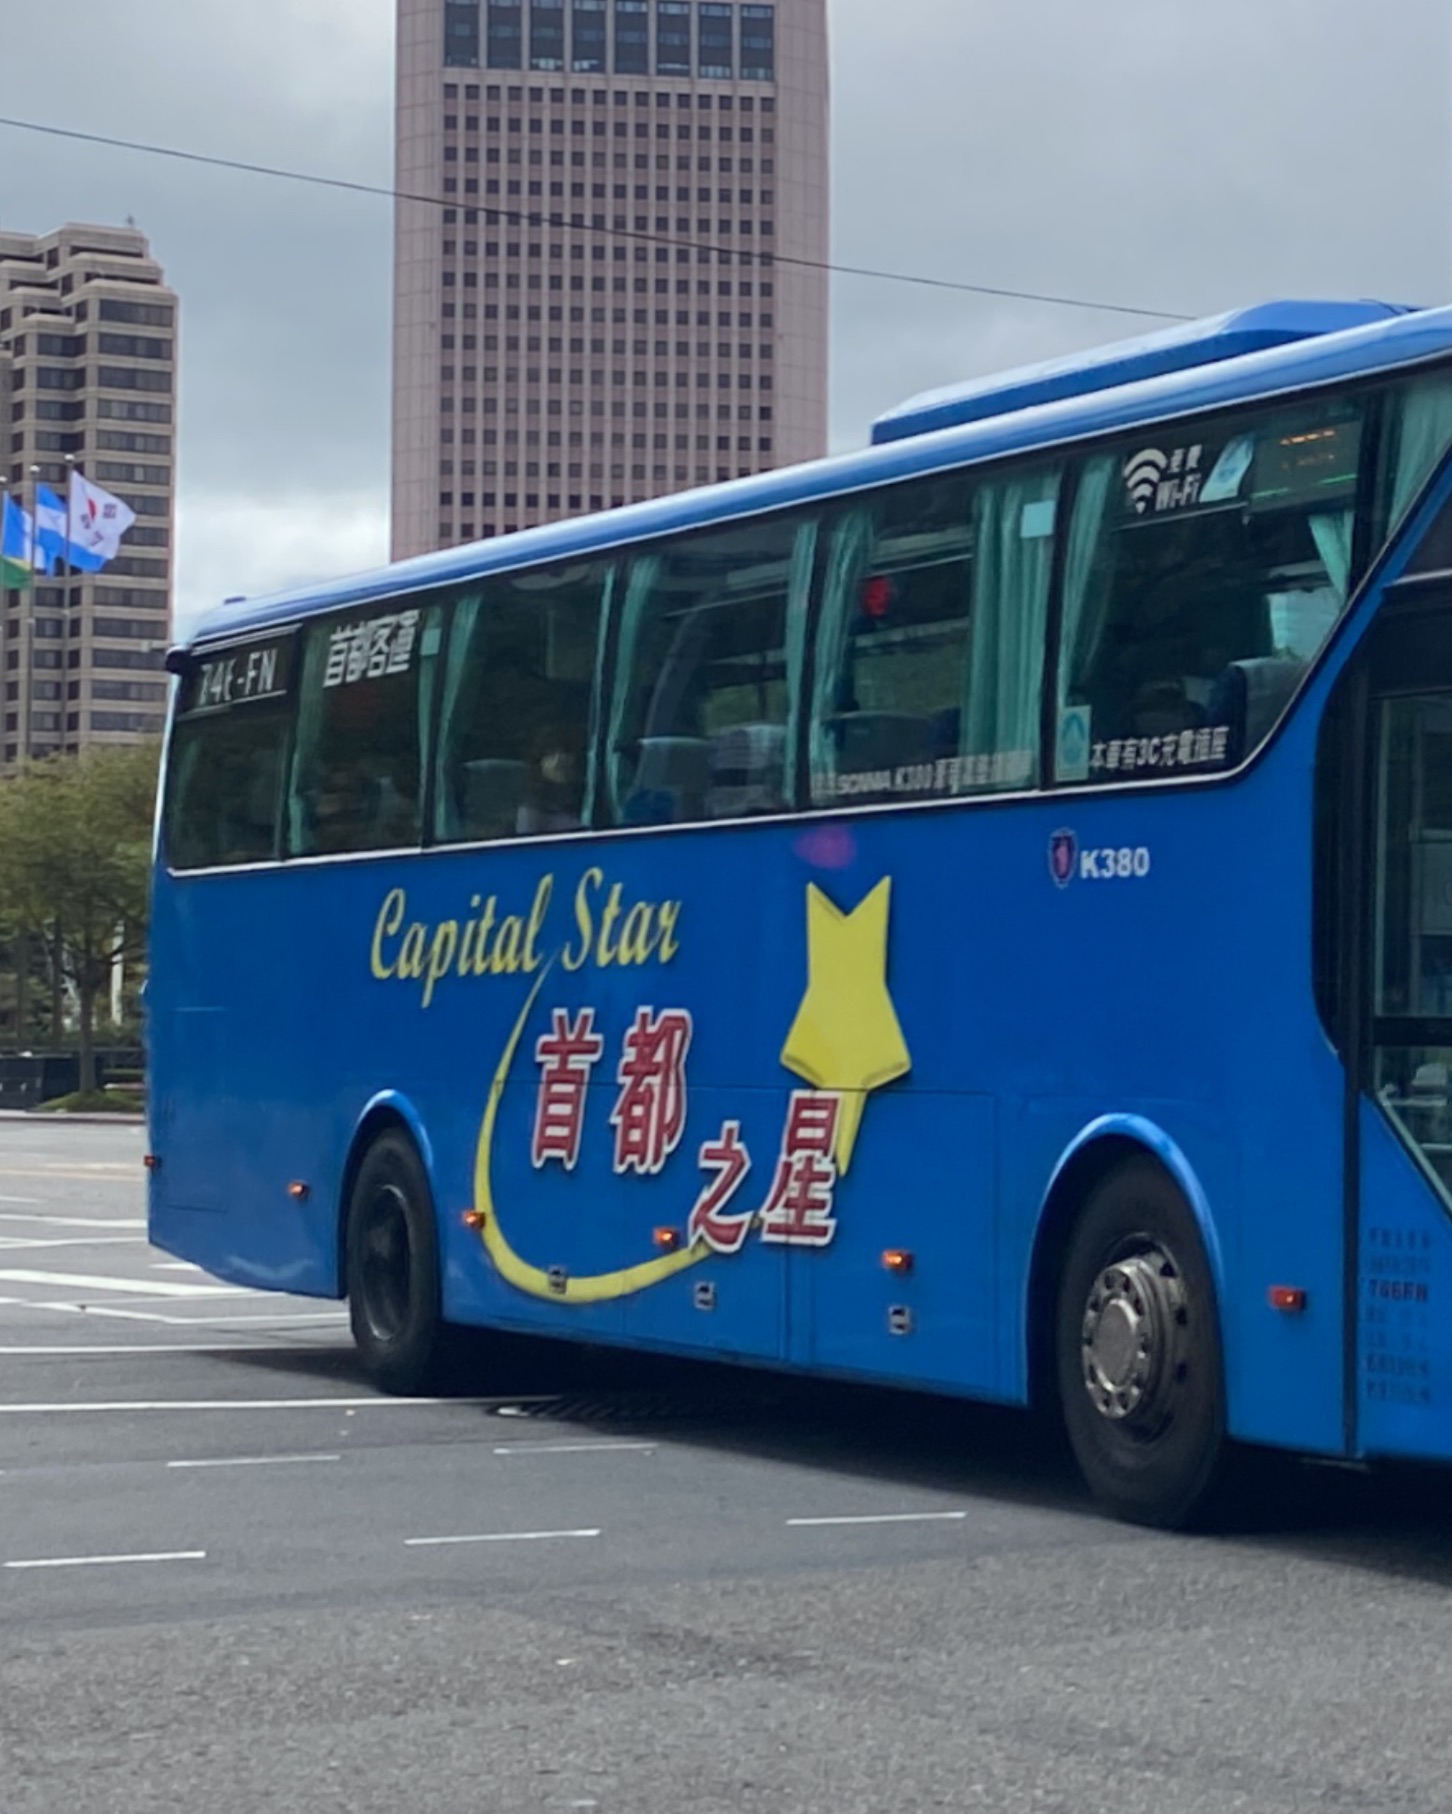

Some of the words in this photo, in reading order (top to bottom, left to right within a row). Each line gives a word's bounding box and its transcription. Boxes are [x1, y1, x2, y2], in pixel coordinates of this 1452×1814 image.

[322, 608, 420, 689] 首都客運
[1079, 846, 1150, 879] K380
[370, 873, 555, 1009] Capital
[561, 866, 682, 972] Star
